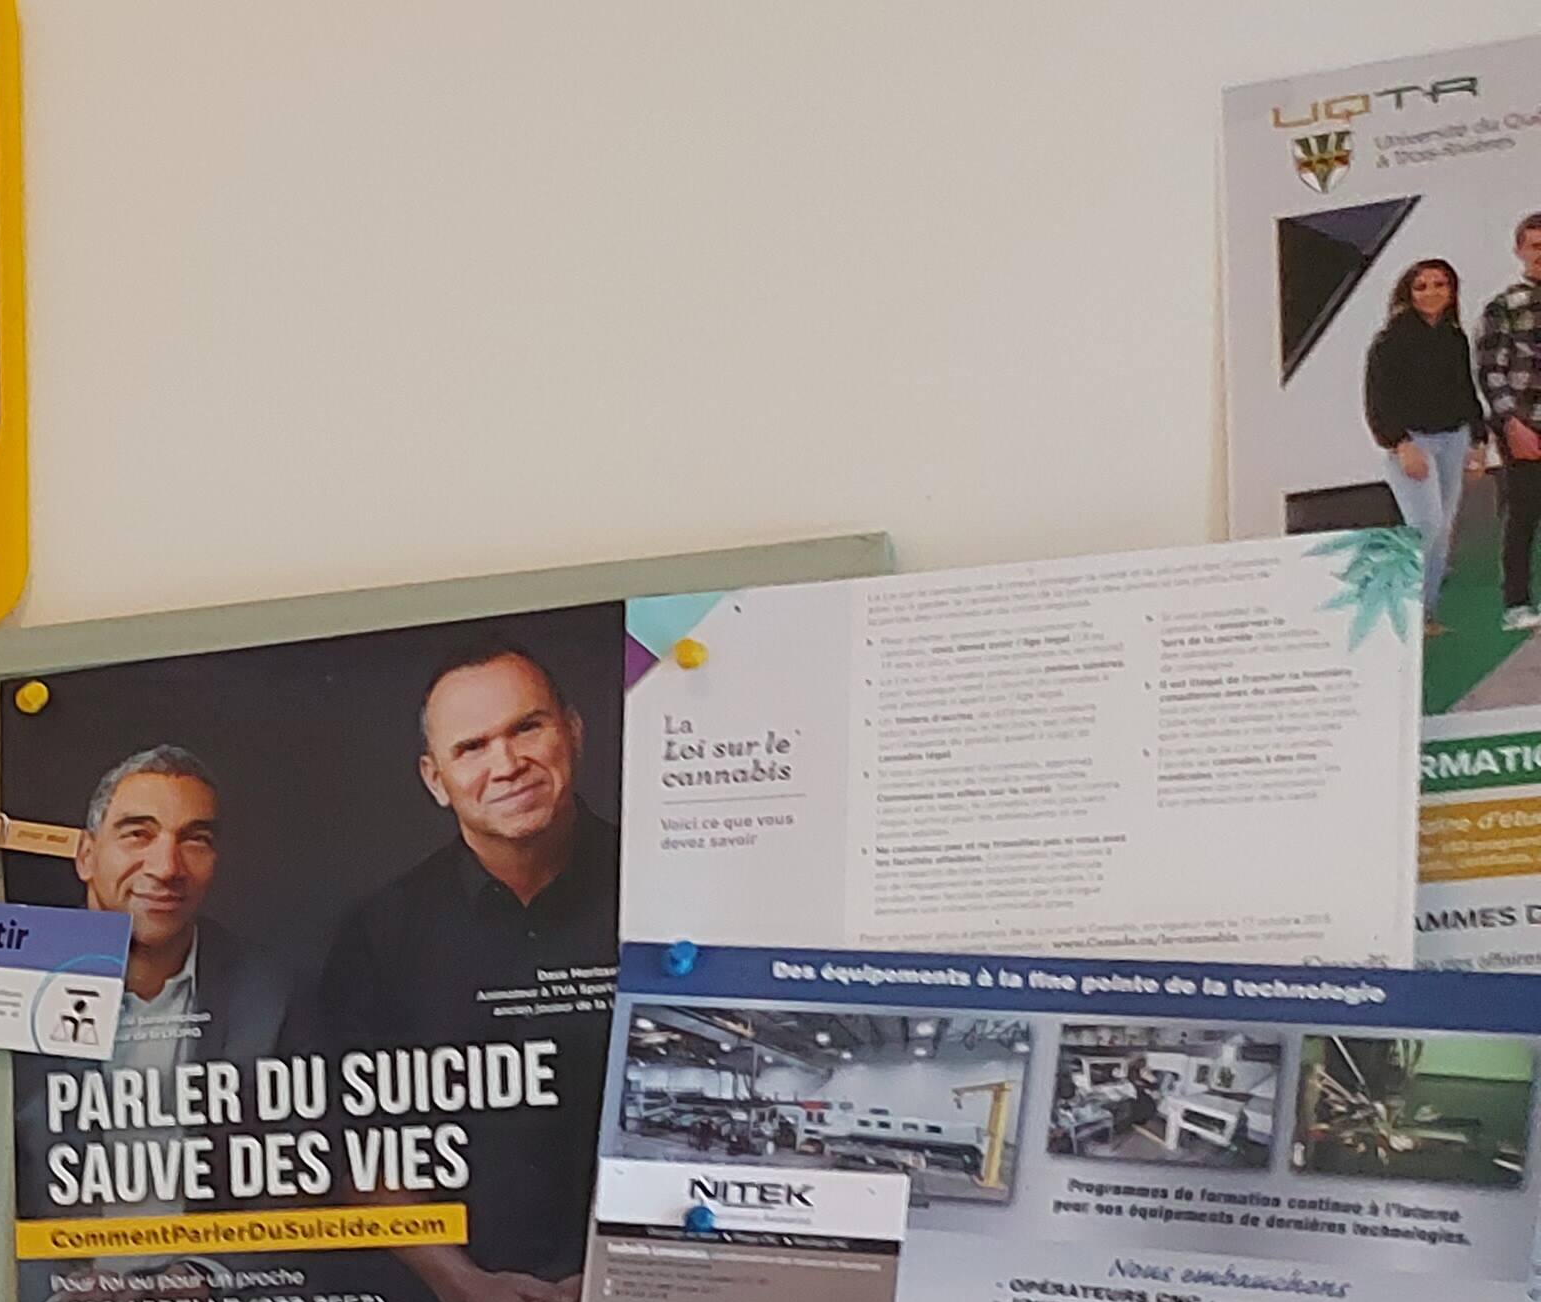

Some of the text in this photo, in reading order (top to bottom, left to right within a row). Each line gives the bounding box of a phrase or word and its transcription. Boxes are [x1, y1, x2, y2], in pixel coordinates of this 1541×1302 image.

[664, 714, 694, 736] La
[662, 730, 791, 762] Loi sur le
[661, 758, 792, 788] cannabis
[702, 818, 720, 830] ce
[723, 816, 754, 831] que
[757, 814, 795, 827] vous
[772, 960, 1387, 1006] Des équipements à la fine pointe de la technologie
[47, 1039, 559, 1134] PARLER DU SUICIDE
[47, 1123, 469, 1206] SAUVE DES VIES
[688, 1173, 816, 1208] NITEK
[1068, 1177, 1169, 1199] Programmes
[1174, 1186, 1194, 1201] de
[1199, 1187, 1282, 1207] formation
[50, 1216, 446, 1250] CommentParlerDuSuicide.com
[1128, 1203, 1234, 1224] équipements
[1239, 1212, 1260, 1227] de
[1266, 1214, 1347, 1235] dernières
[50, 1272, 94, 1292] Pour
[98, 1271, 123, 1291] toi
[157, 1272, 206, 1294] pour
[208, 1271, 234, 1290] un
[236, 1268, 306, 1291] proche
